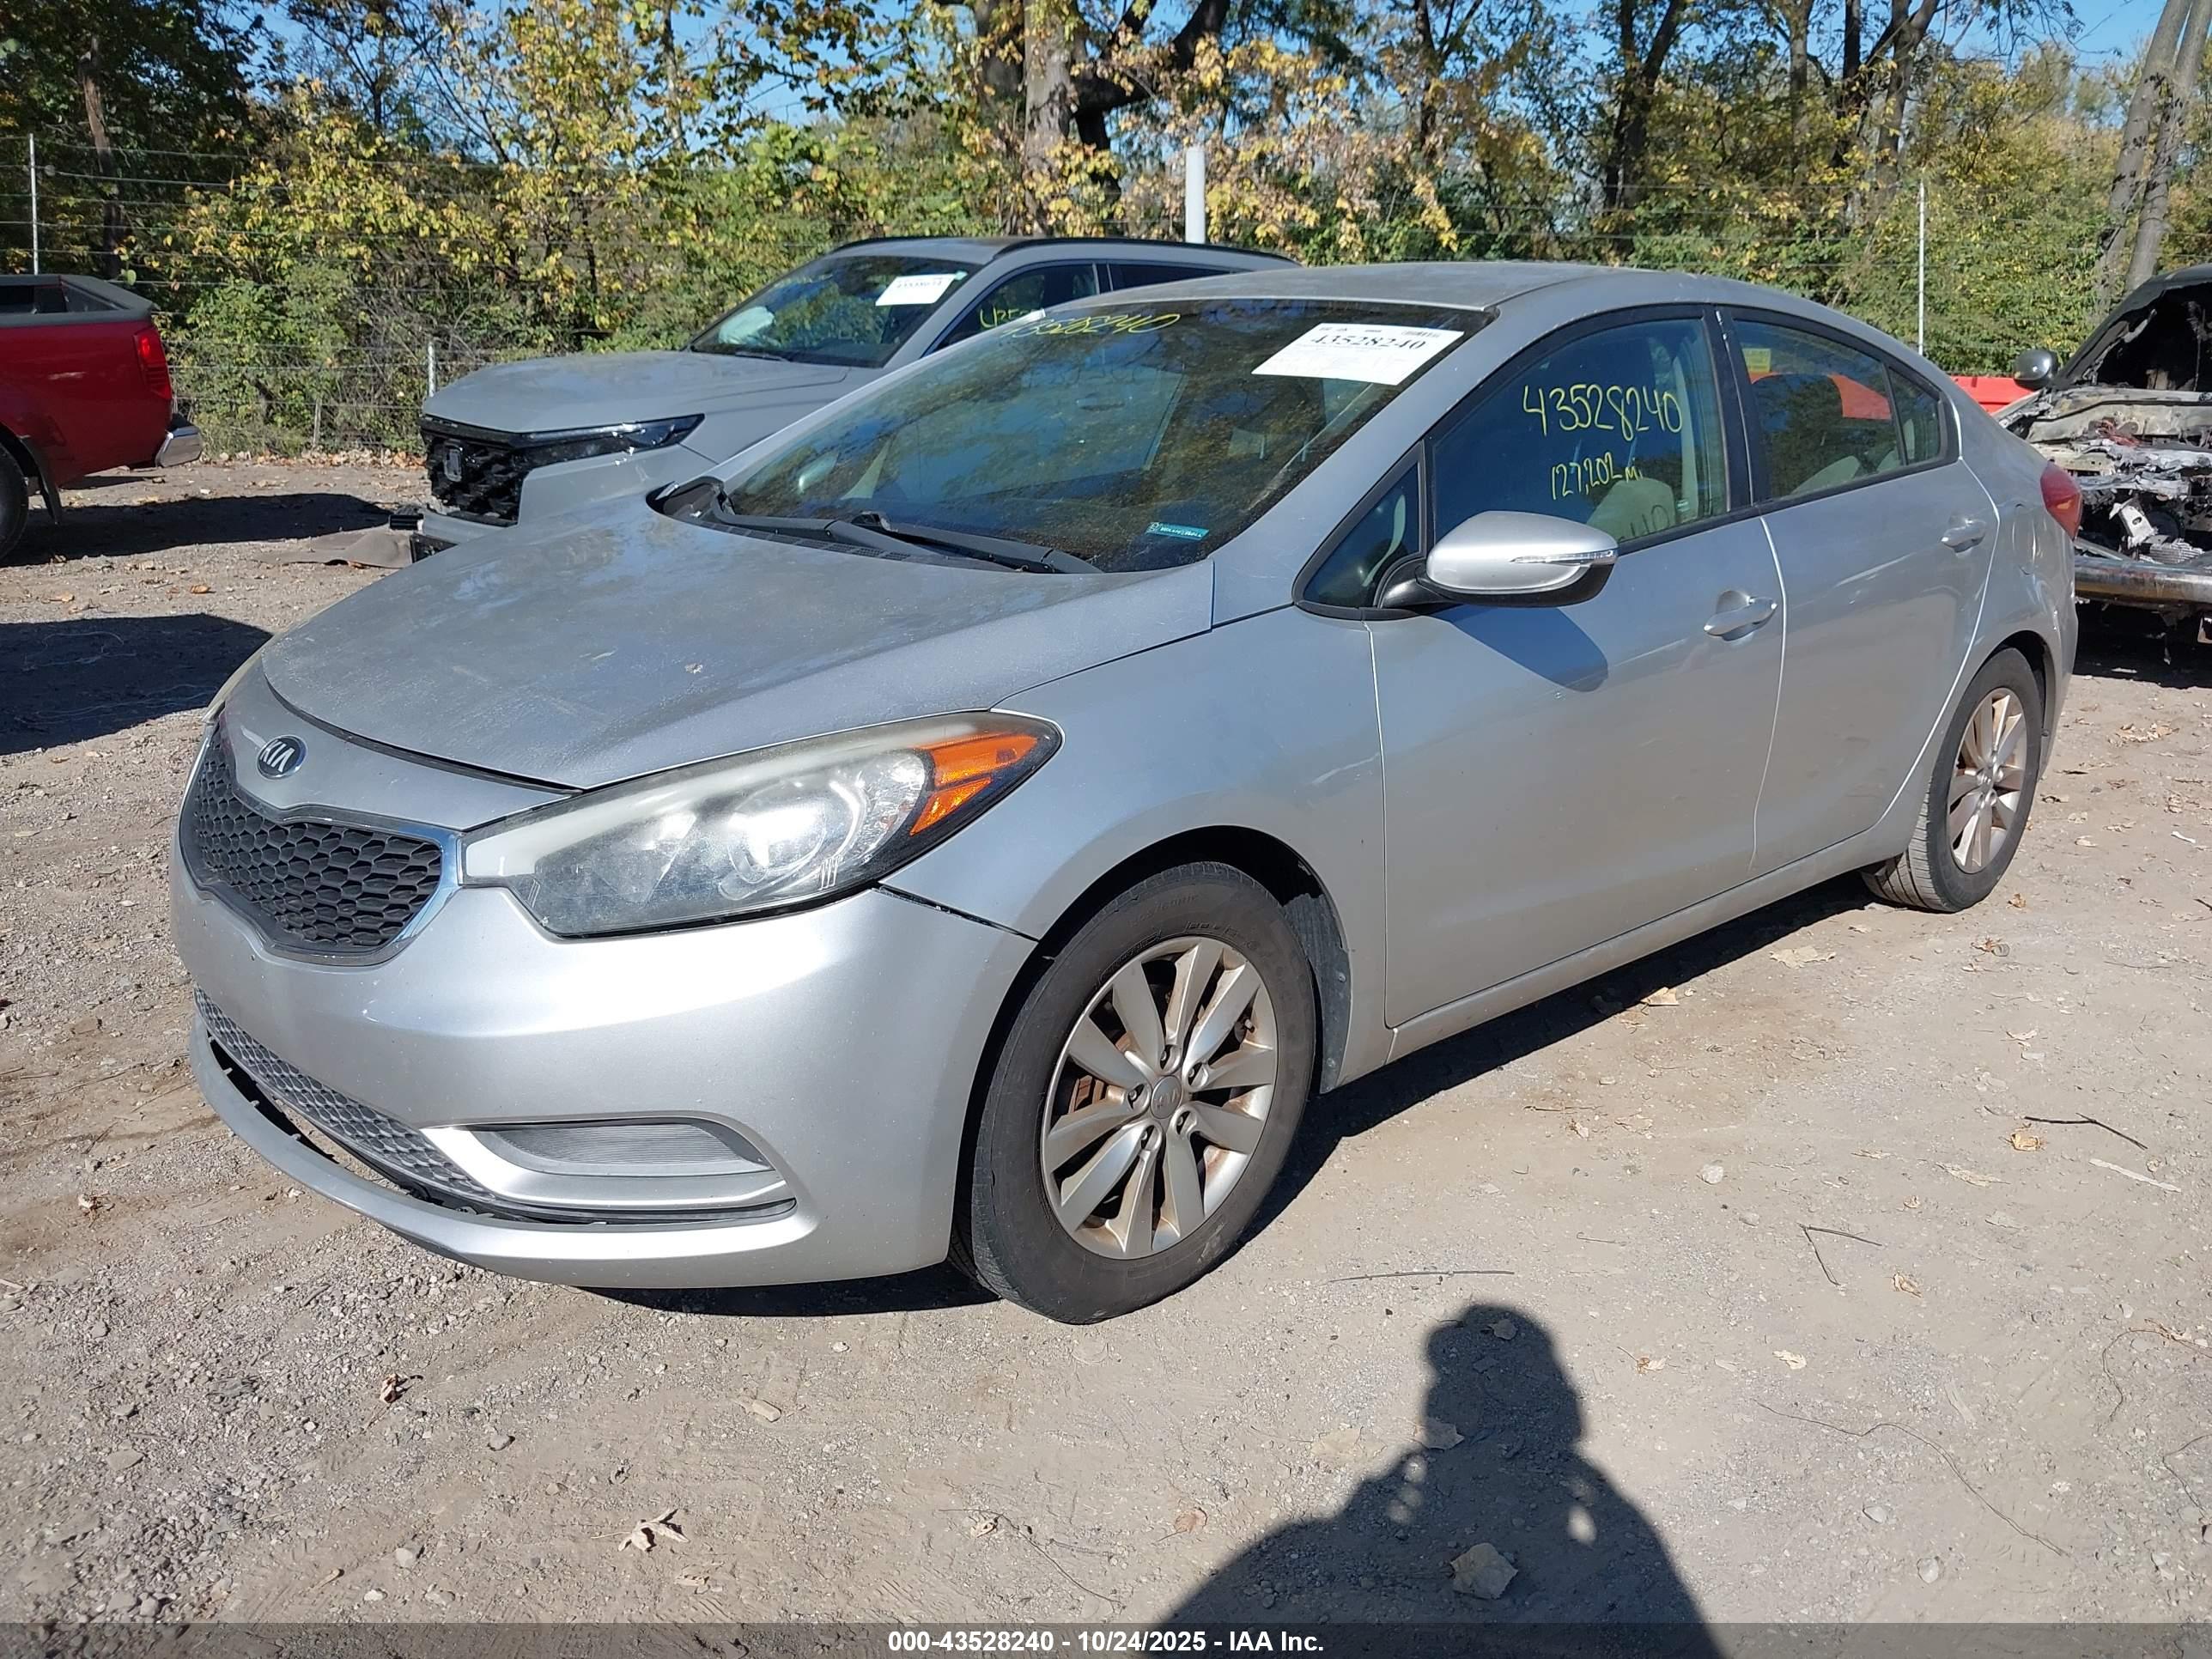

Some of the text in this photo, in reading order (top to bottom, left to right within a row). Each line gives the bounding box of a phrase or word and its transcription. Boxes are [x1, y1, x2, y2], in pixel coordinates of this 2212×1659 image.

[1310, 333, 1427, 350] 43528240
[1522, 384, 1683, 441] 43528240
[1551, 452, 1623, 501] 127,202
